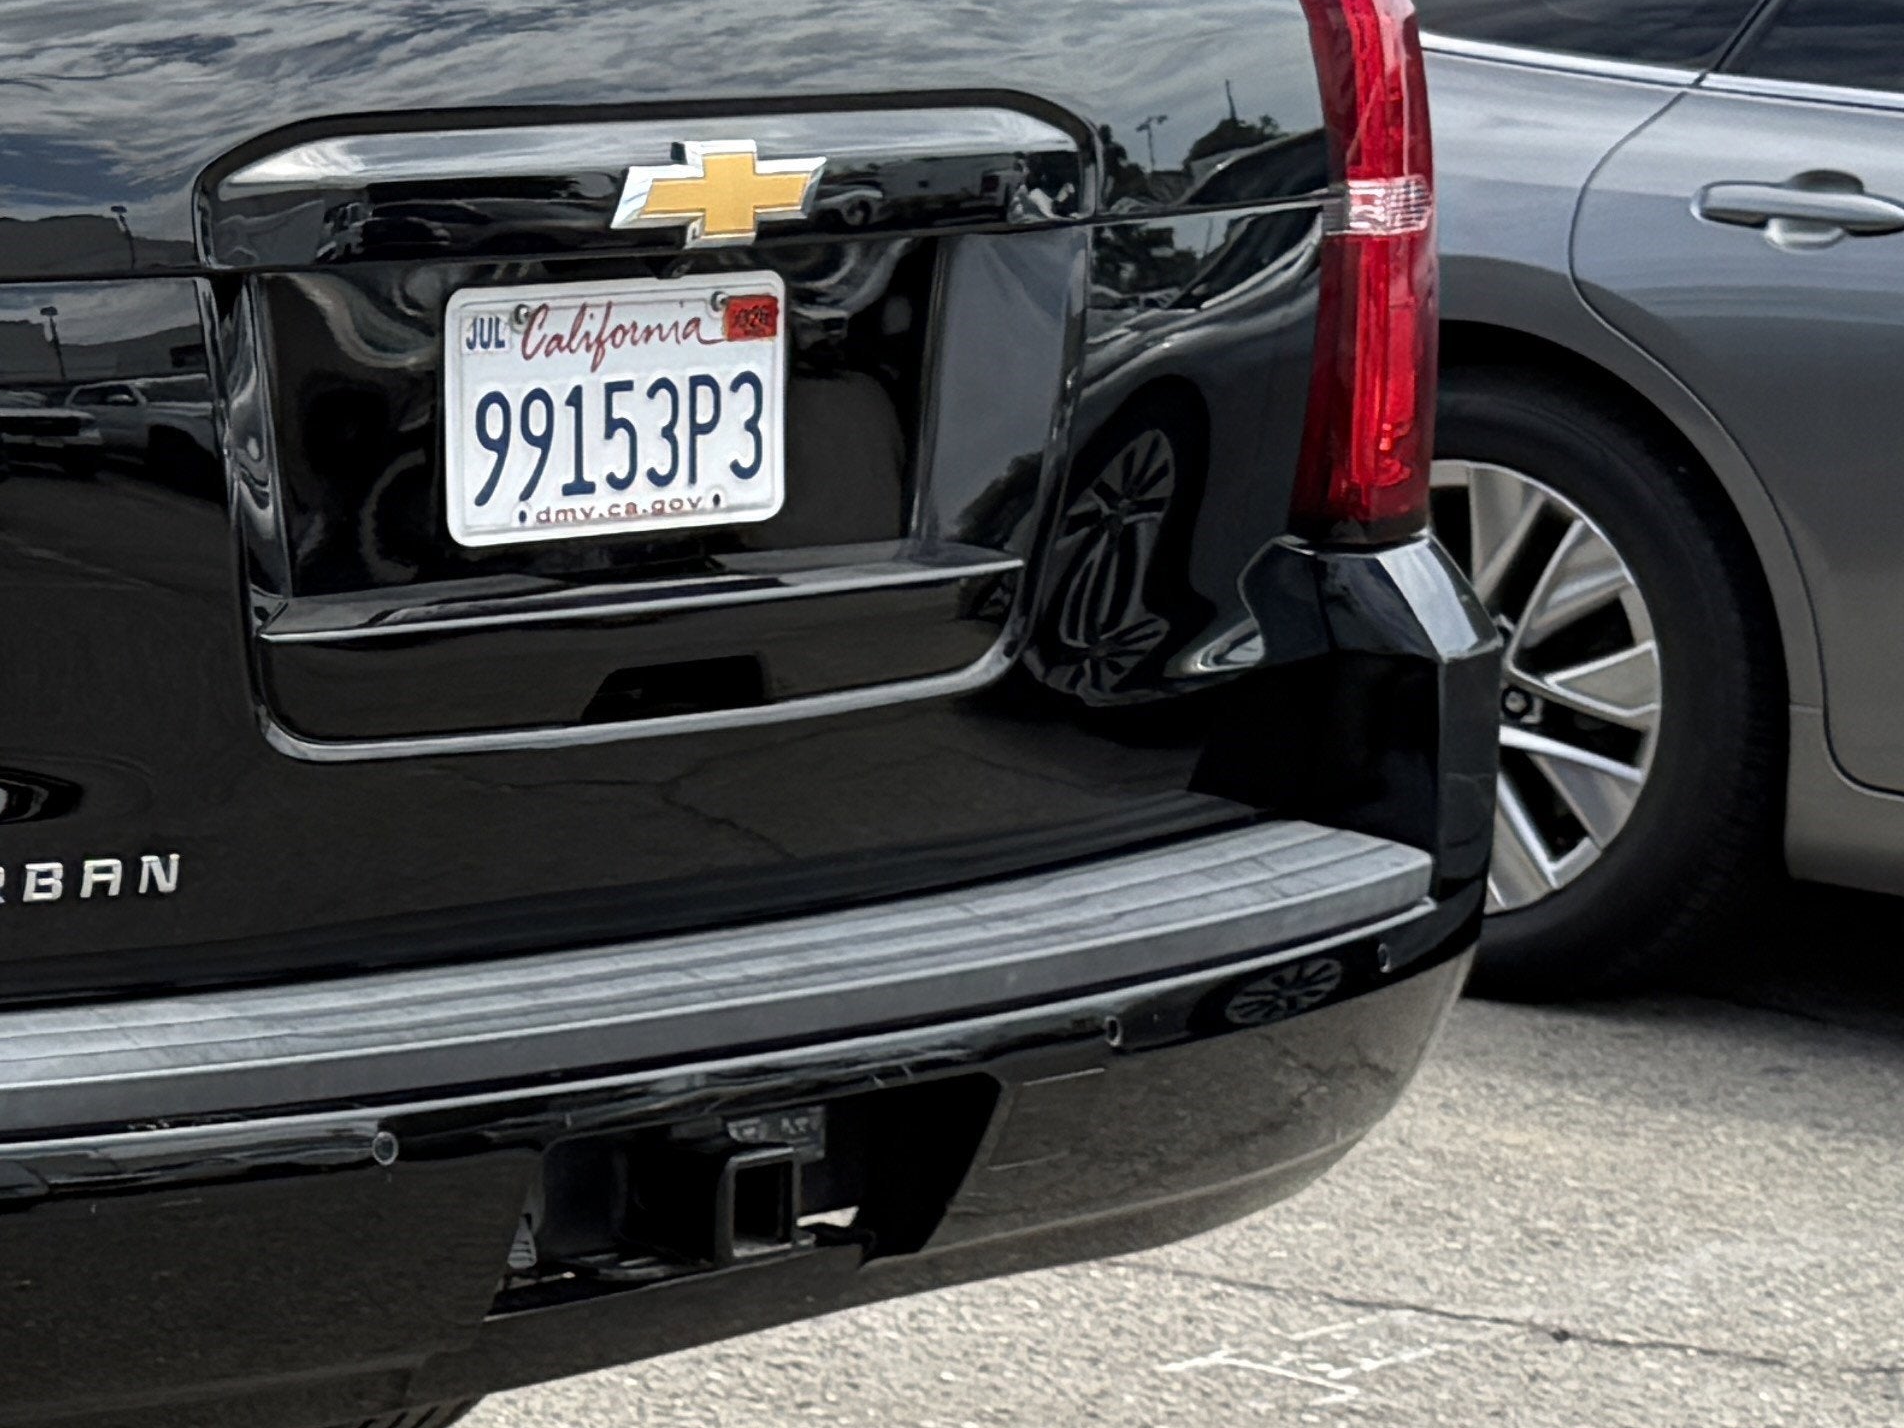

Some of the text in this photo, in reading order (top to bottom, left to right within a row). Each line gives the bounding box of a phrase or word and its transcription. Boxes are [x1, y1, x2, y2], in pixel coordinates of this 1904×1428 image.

[465, 316, 506, 350] JUL
[521, 299, 728, 373] California
[474, 370, 764, 507] 99153P3
[535, 494, 703, 525] dmv.ca.gov
